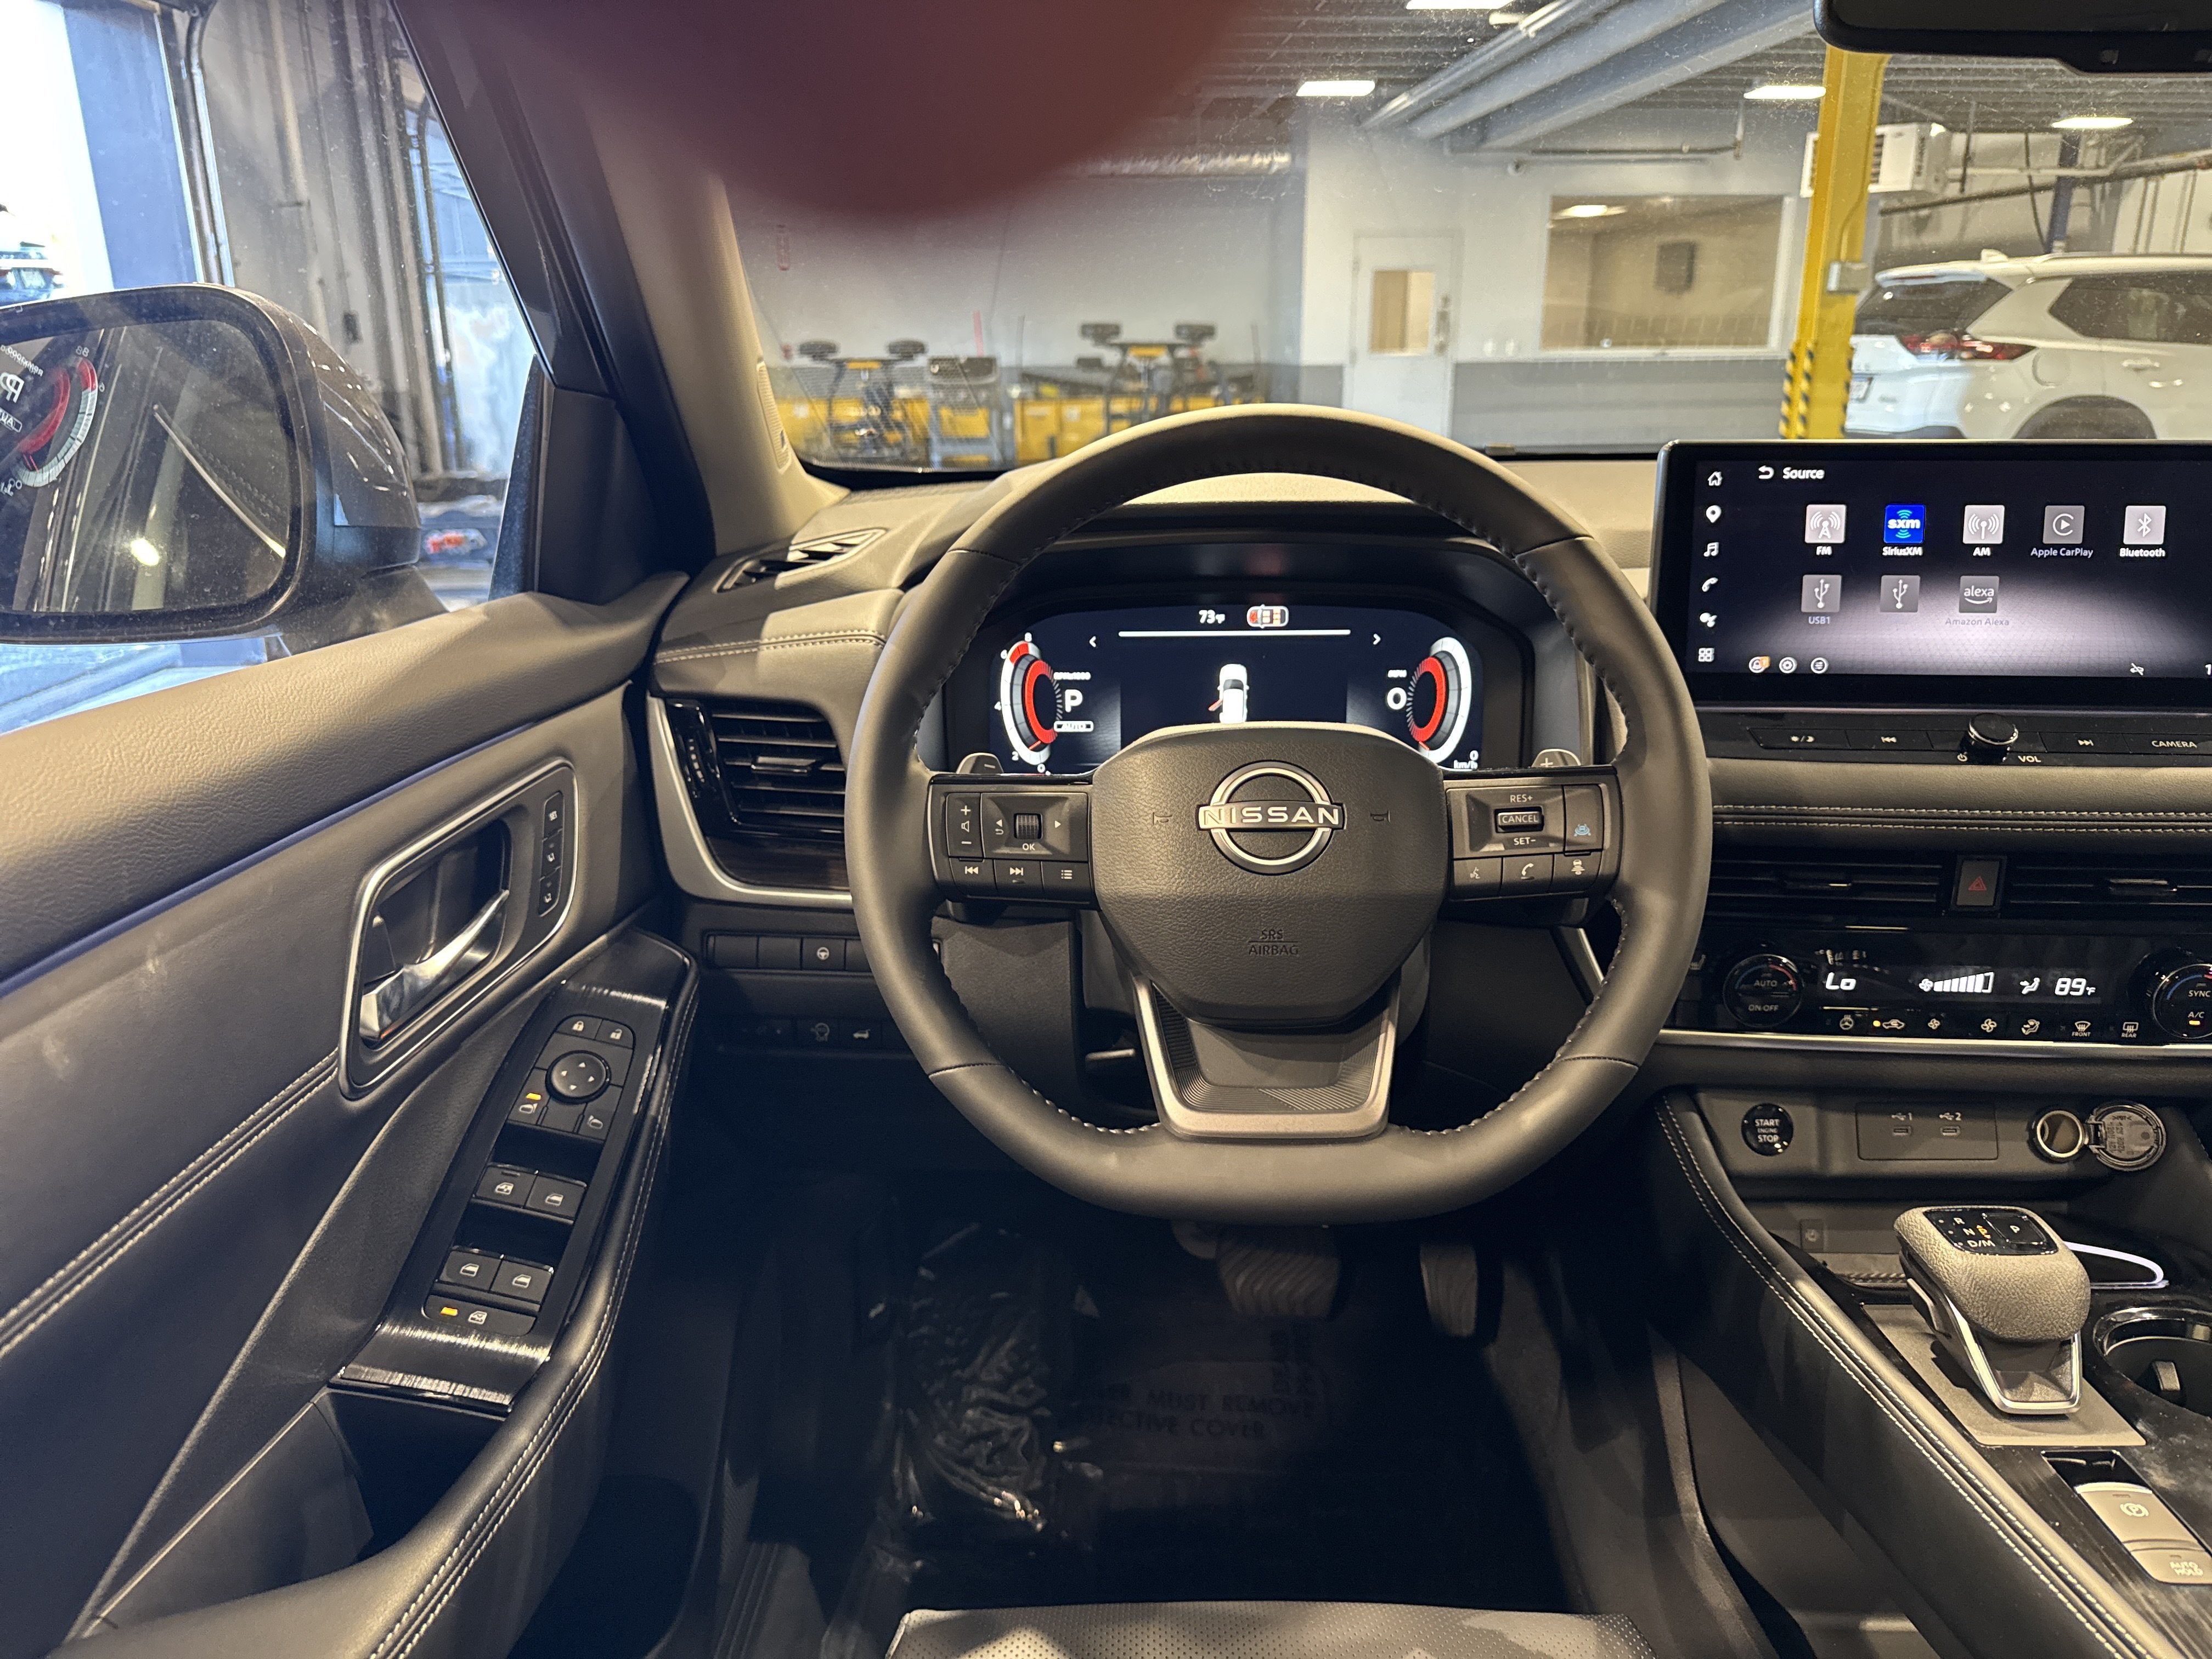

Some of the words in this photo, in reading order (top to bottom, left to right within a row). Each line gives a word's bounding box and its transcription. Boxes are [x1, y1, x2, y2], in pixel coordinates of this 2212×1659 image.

[1782, 467, 1825, 479] Source
[1888, 518, 1920, 529] sxm
[1816, 546, 1832, 556] FM
[1882, 546, 1922, 556] SiriusXM
[1973, 548, 1991, 556] AM
[2030, 548, 2058, 558] Apple
[2059, 548, 2094, 558] CarPlay
[2119, 548, 2165, 557] Bluetooth
[1963, 585, 1995, 597] alexa
[1808, 616, 1830, 625] USB1
[1945, 618, 1982, 626] Amazon
[1984, 618, 2010, 626] Alexa
[1024, 633, 1032, 642] 8
[1000, 650, 1008, 659] 6
[1065, 689, 1083, 713] P
[994, 701, 1001, 711] 4
[2151, 740, 2198, 748] CAMERA
[1012, 751, 1019, 761] 2
[1469, 750, 1479, 761] 0
[1037, 764, 1046, 773] 0
[1453, 759, 1479, 770] km/h
[1510, 794, 1533, 803] RES+
[1204, 806, 1339, 826] NISSAN
[1502, 814, 1538, 823] CANCEL
[1514, 837, 1536, 845] SET-
[1022, 843, 1036, 851] OK
[1261, 929, 1283, 940] SRS
[1248, 944, 1299, 955] AIRBAG
[1826, 972, 1857, 990] Lo
[1955, 1112, 1961, 1120] 2
[1755, 1119, 1780, 1127] START
[1758, 1135, 1779, 1143] STOP
[2010, 1225, 2020, 1233] P
